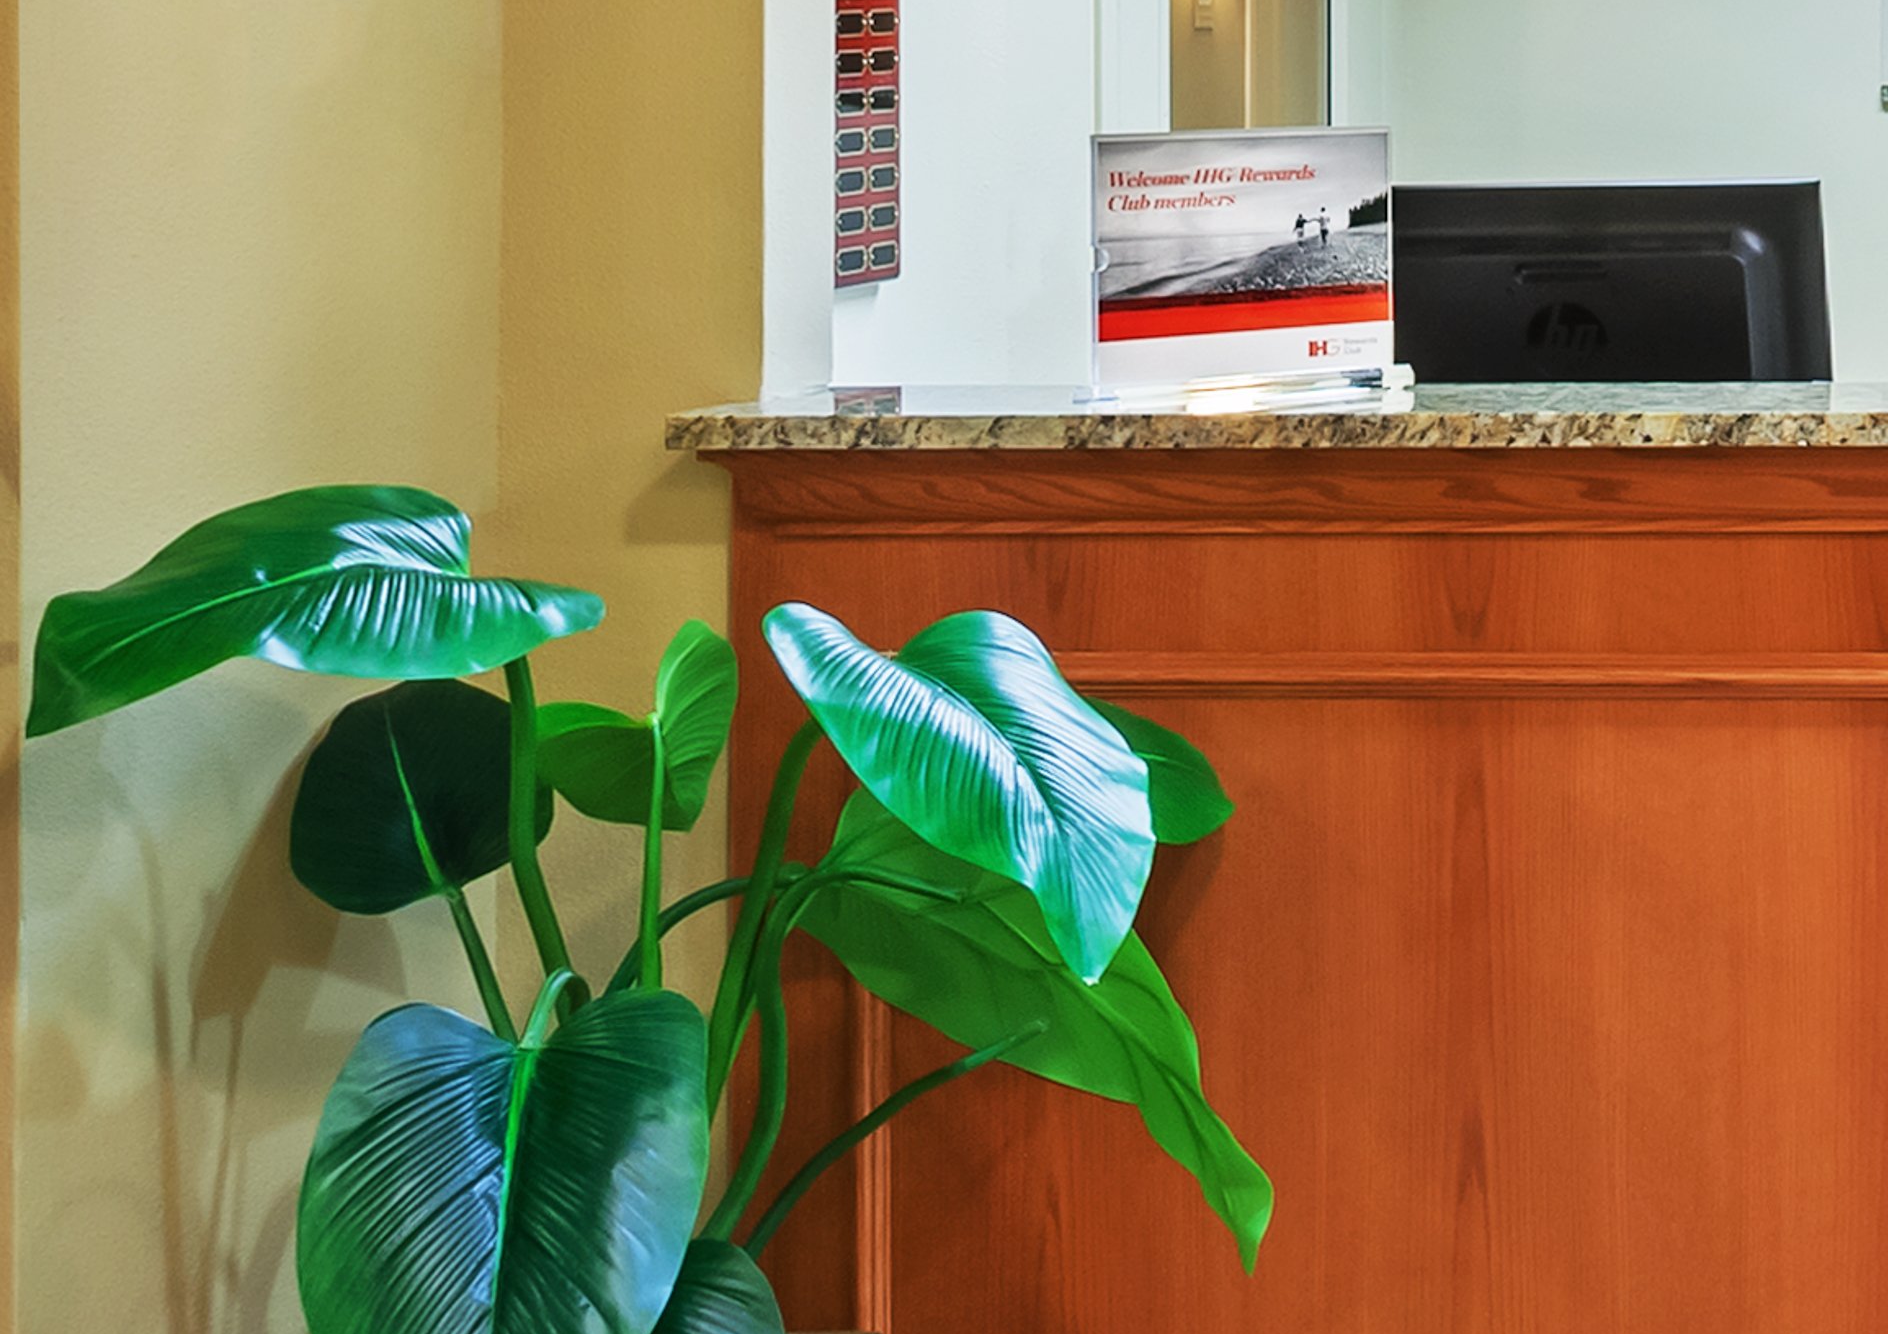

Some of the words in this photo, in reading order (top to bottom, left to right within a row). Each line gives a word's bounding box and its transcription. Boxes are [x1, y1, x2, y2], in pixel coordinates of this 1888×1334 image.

[1108, 169, 1190, 188] Welcome
[1192, 167, 1233, 185] IHG
[1239, 164, 1316, 183] Rewards
[1108, 194, 1151, 212] Club
[1153, 190, 1237, 208] members
